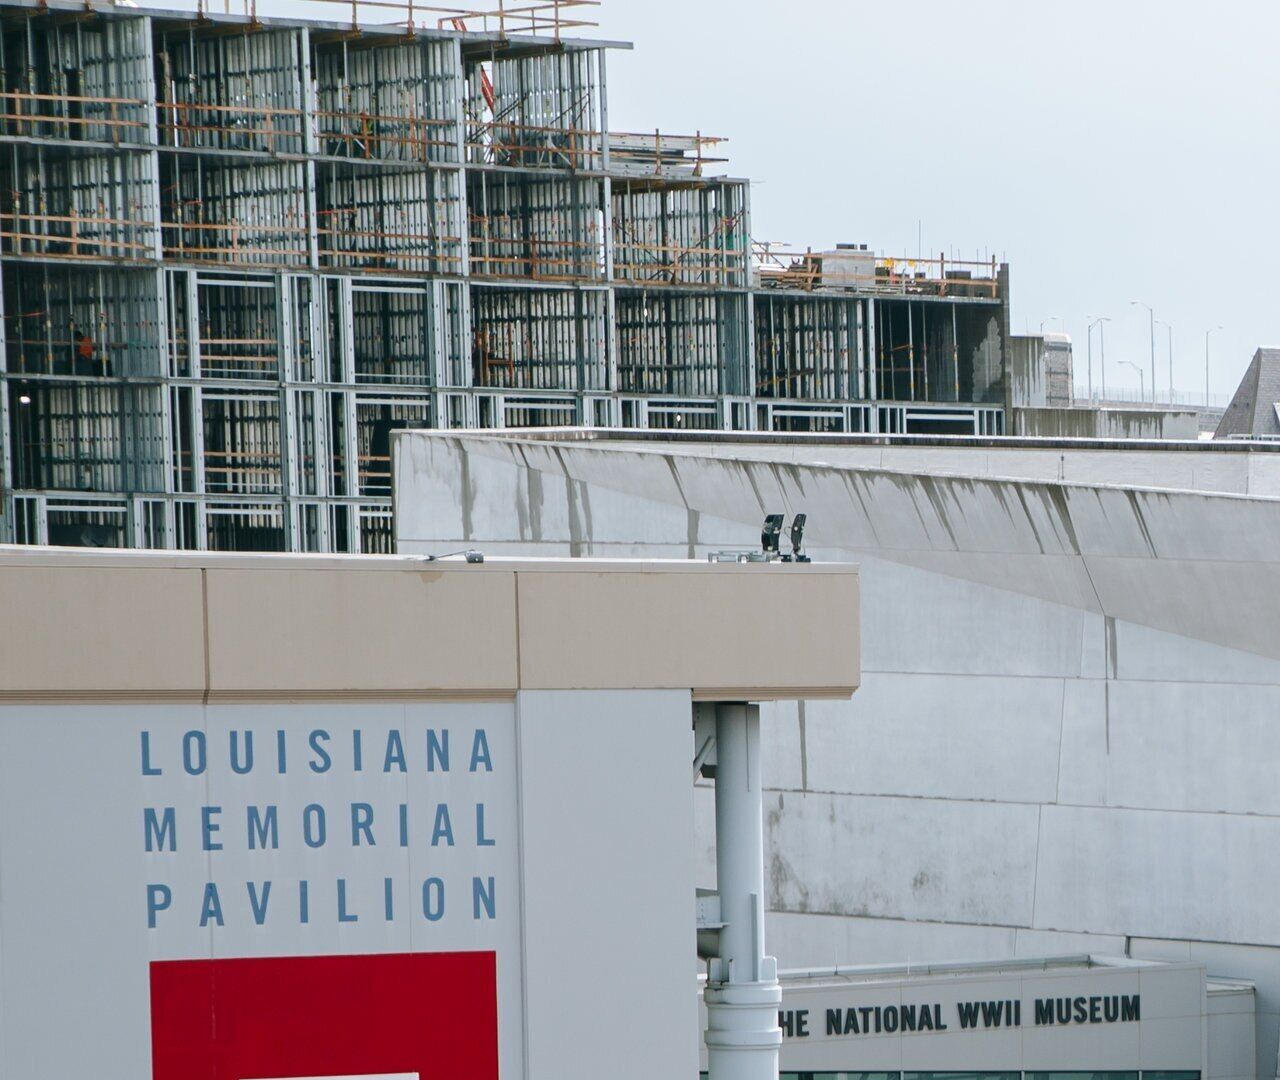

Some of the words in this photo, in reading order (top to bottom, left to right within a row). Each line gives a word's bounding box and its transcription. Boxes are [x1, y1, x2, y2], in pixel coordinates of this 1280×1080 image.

[140, 729, 493, 775] LOUISIANA
[143, 802, 496, 852] MEMORIAL
[146, 876, 496, 928] PAVILION
[778, 1009, 810, 1038] HE
[826, 1003, 947, 1036] NATIONAL
[957, 1000, 1022, 1028] WWII
[1035, 995, 1141, 1025] MUSEUM
